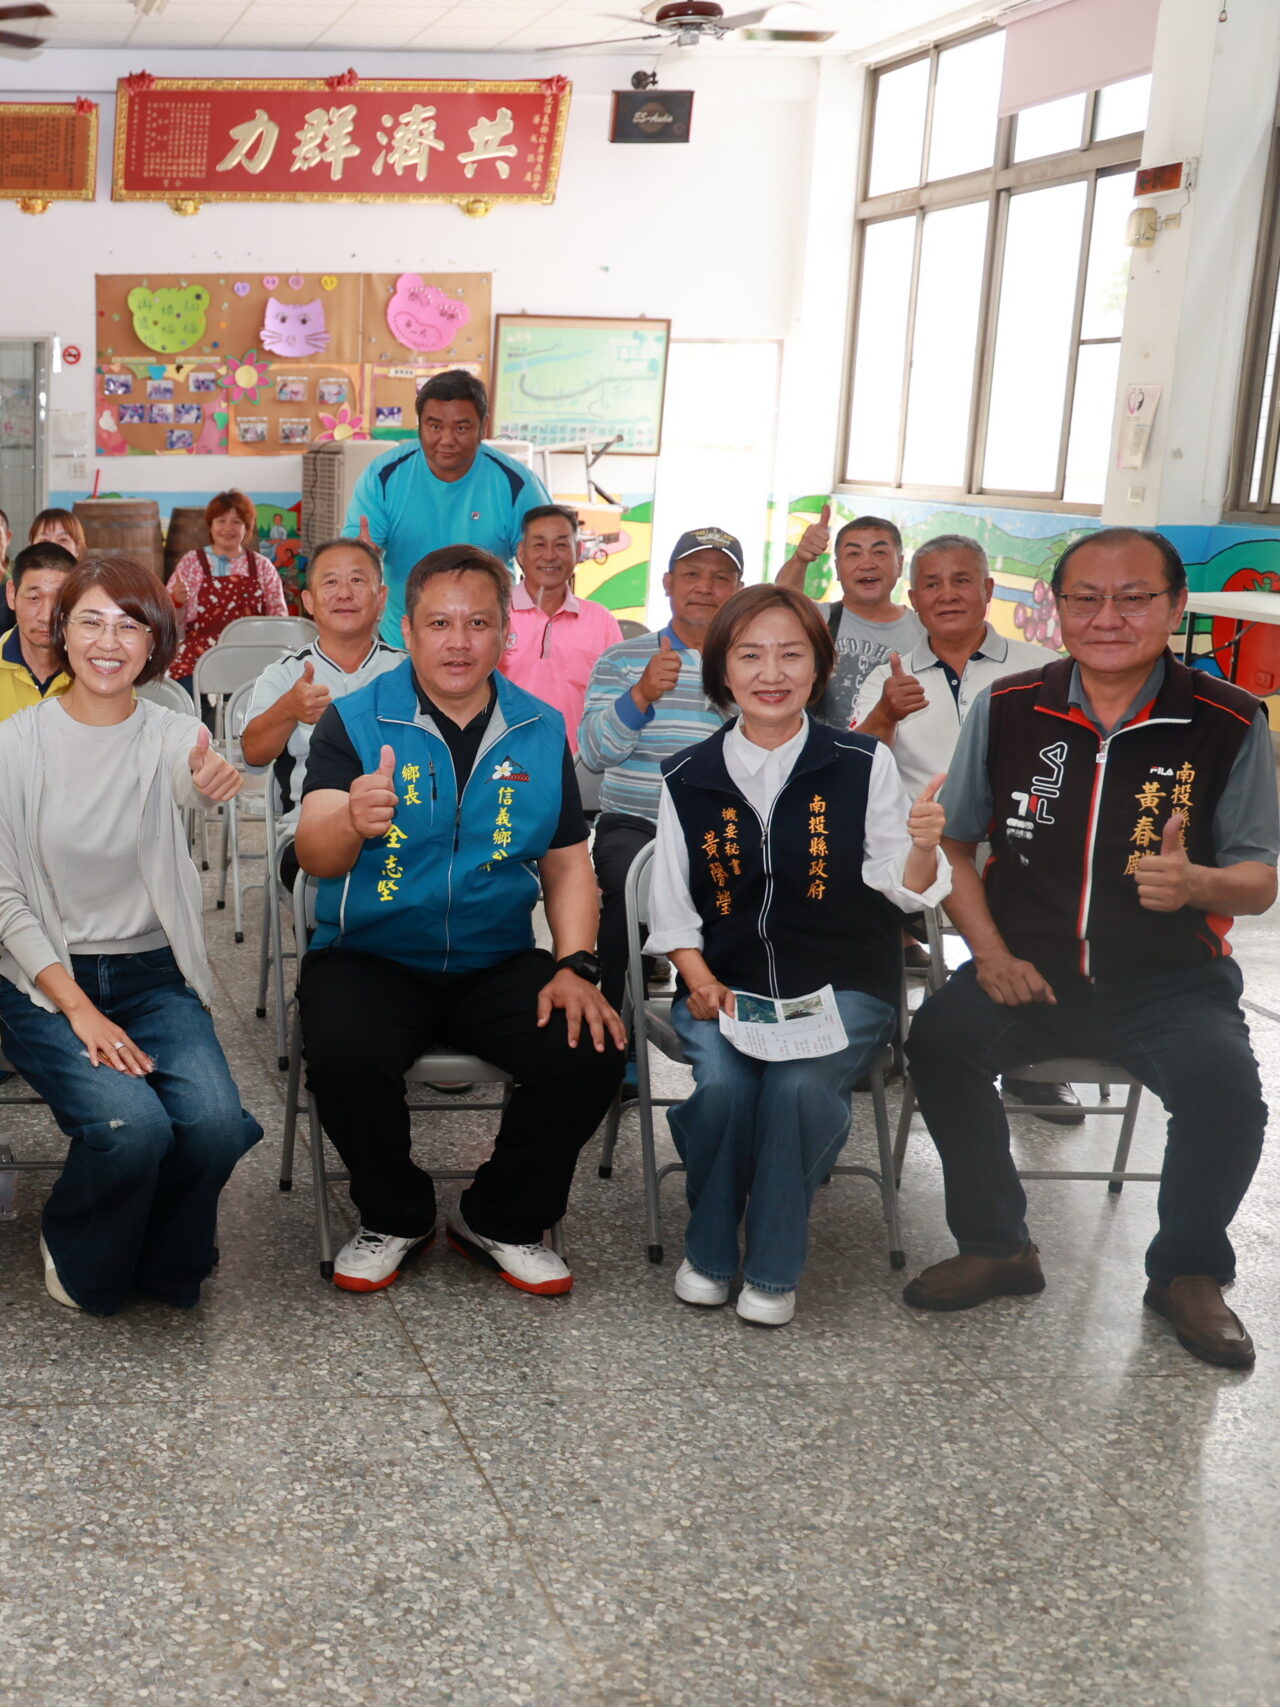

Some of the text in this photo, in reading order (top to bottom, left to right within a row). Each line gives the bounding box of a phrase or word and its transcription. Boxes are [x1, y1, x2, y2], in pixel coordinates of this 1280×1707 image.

[216, 103, 518, 182] 共濟群力
[632, 111, 674, 124] ES-Audio
[401, 763, 423, 806] 鄉長
[1030, 741, 1068, 825] FILA
[1149, 765, 1175, 777] FILA
[806, 794, 830, 900] 南投縣政府
